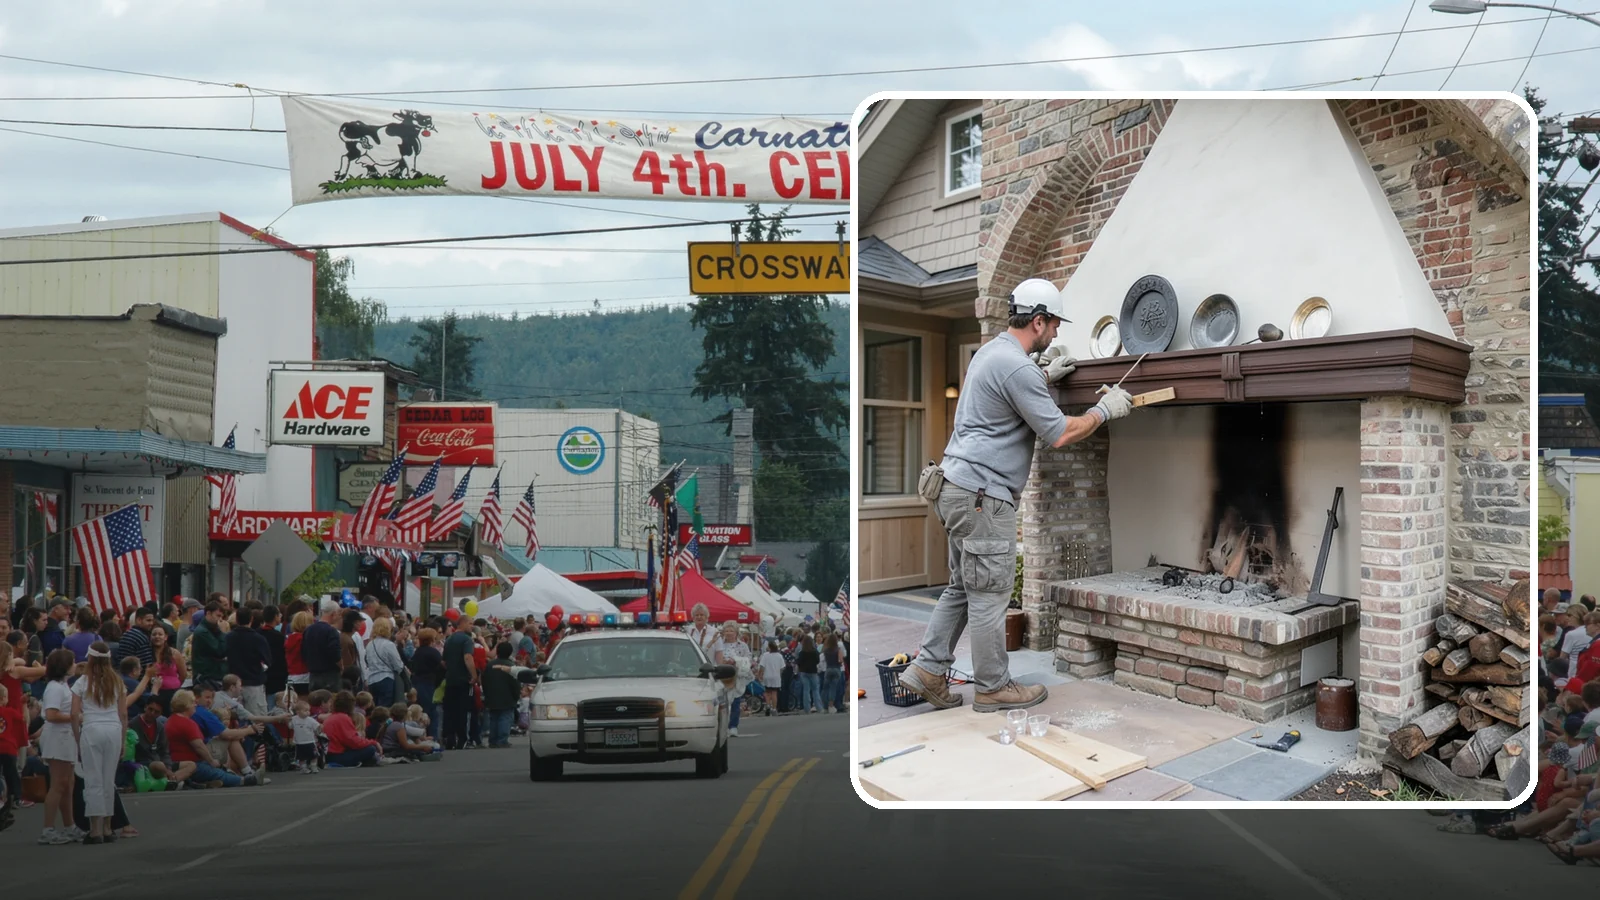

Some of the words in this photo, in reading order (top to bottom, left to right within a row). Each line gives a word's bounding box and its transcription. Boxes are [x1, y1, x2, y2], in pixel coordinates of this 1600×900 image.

[481, 141, 605, 192] JULY
[632, 150, 746, 198] 4th.
[697, 254, 850, 280] CROSSWA
[283, 380, 373, 420] ACE
[406, 409, 452, 422] CEDAR
[461, 409, 485, 422] LOG
[283, 421, 371, 436] Hardware
[416, 428, 477, 447] Coca-Cola
[353, 467, 386, 480] Simpl
[83, 485, 94, 494] St.
[96, 485, 124, 495] Vincent
[126, 486, 135, 495] de
[138, 486, 155, 495] Paul
[81, 503, 154, 522] THT
[213, 516, 330, 535] HARDARE
[688, 526, 741, 535] CRNATION
[699, 535, 730, 543] GLASS
